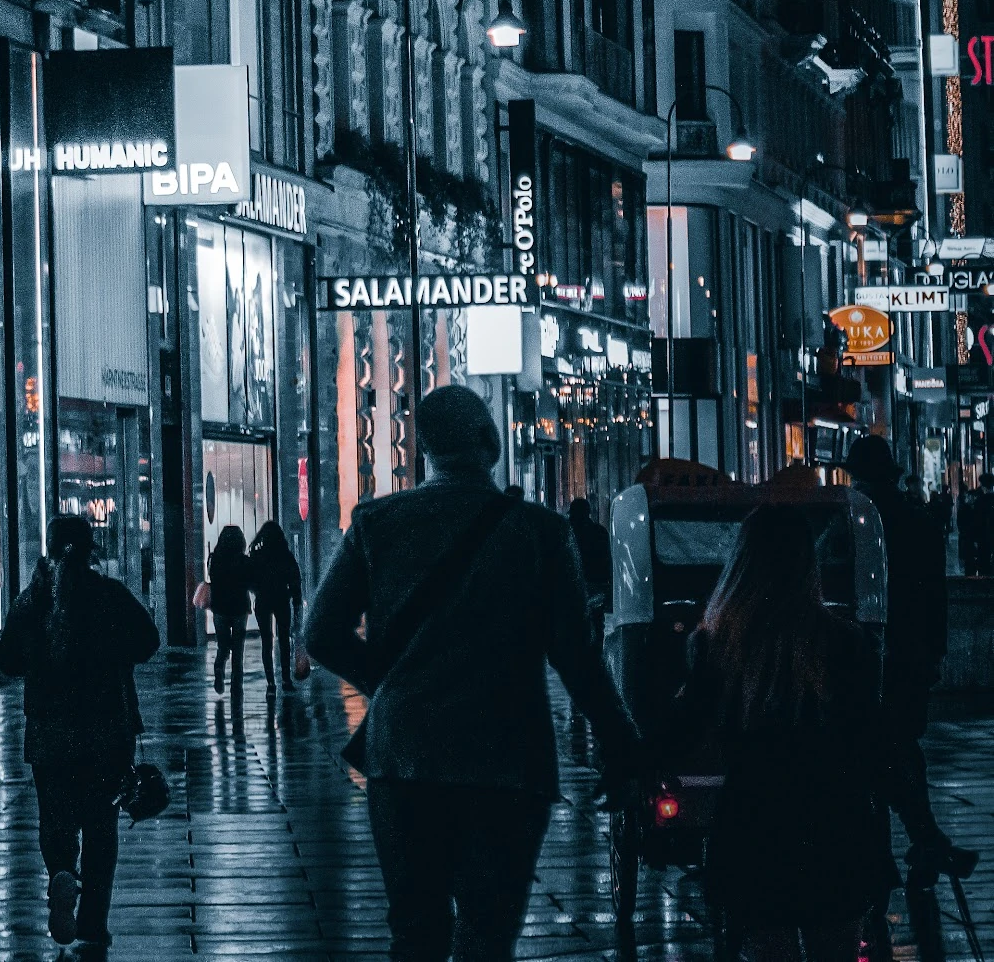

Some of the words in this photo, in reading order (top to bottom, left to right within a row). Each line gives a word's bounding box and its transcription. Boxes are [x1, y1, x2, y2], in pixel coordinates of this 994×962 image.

[56, 142, 168, 170] HUMANIC
[152, 161, 239, 196] BIPA
[334, 275, 528, 307] SALAMANDER
[891, 291, 947, 306] KLIMT
